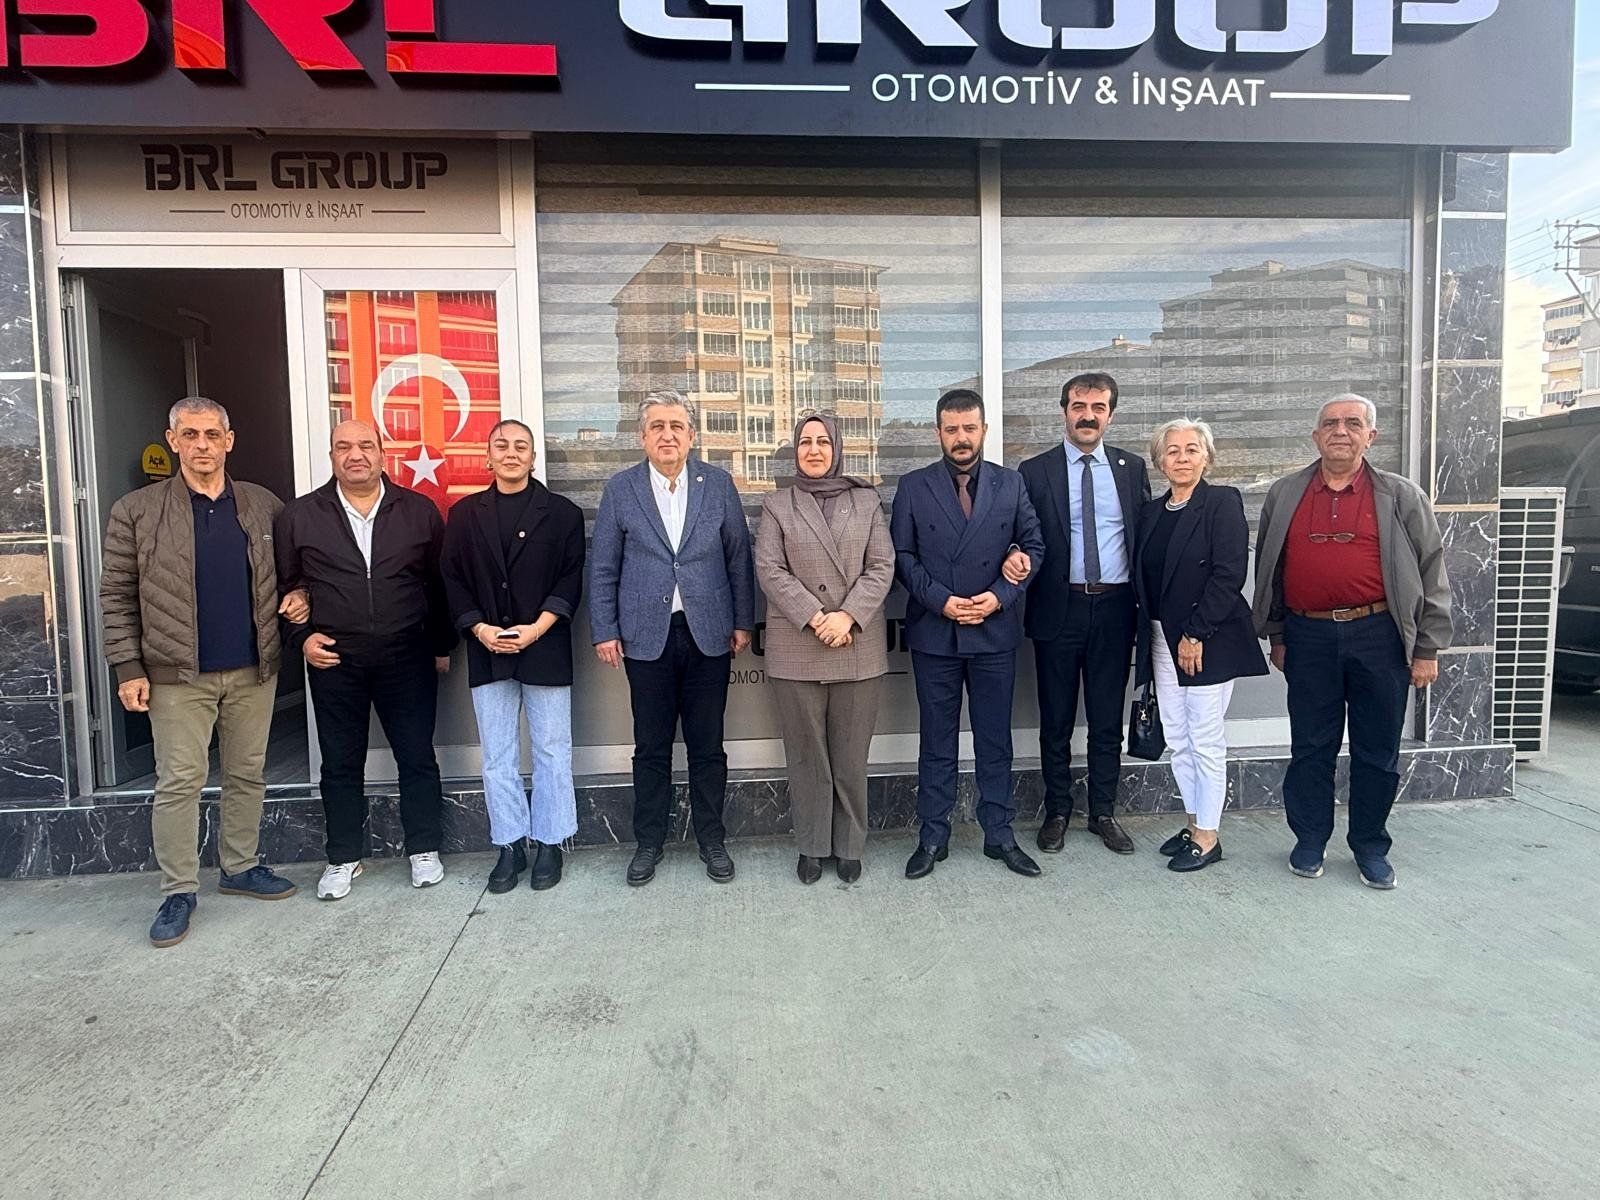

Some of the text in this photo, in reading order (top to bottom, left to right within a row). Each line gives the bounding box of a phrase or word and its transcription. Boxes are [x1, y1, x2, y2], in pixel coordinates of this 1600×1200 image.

[871, 71, 1266, 112] OTOMOTİV & İNŞAAT
[139, 143, 448, 192] BRL GROUP
[230, 200, 364, 222] OTOMOTİV & İNŞAAT
